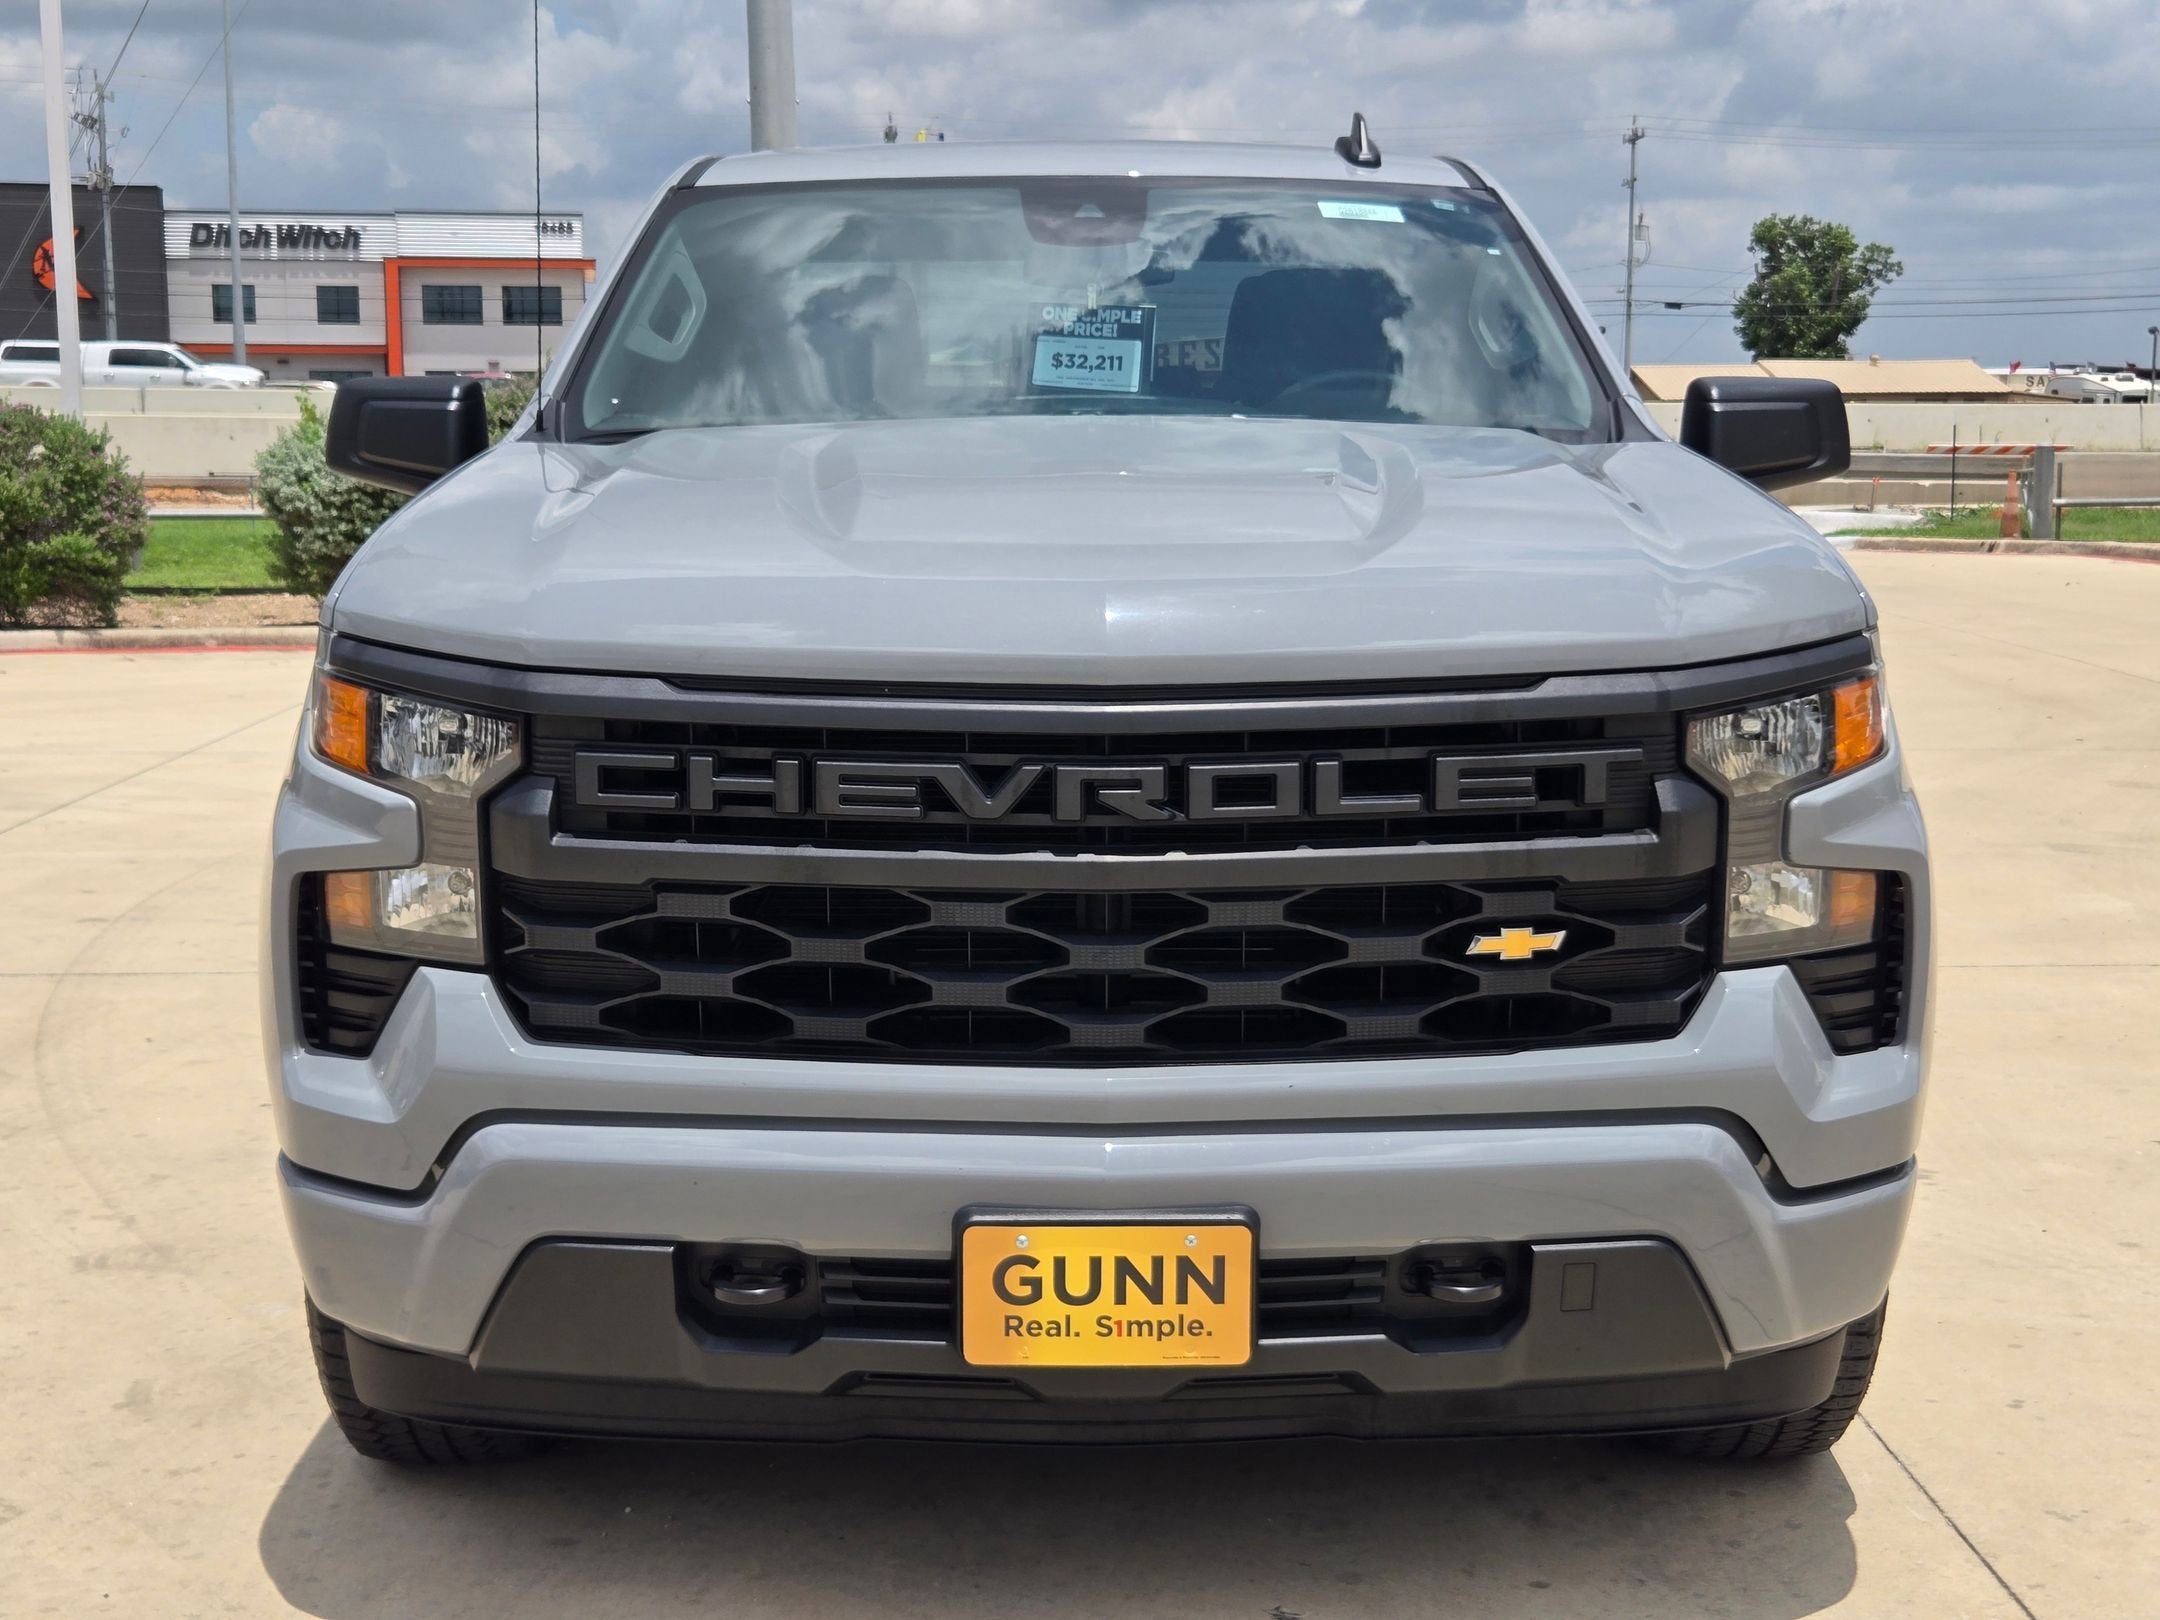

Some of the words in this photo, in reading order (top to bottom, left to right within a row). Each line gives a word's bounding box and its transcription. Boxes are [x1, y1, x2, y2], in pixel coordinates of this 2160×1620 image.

[189, 223, 272, 249] Ditch
[276, 224, 361, 250] Witch
[1042, 306, 1079, 322] ONE
[1063, 321, 1118, 337] PRICE!
[1050, 352, 1124, 373] $32,211
[575, 747, 1645, 822] CHEVROLET
[992, 1254, 1226, 1306] GUNN
[1003, 1314, 1081, 1338] Real.
[1095, 1314, 1213, 1342] S1mple.
